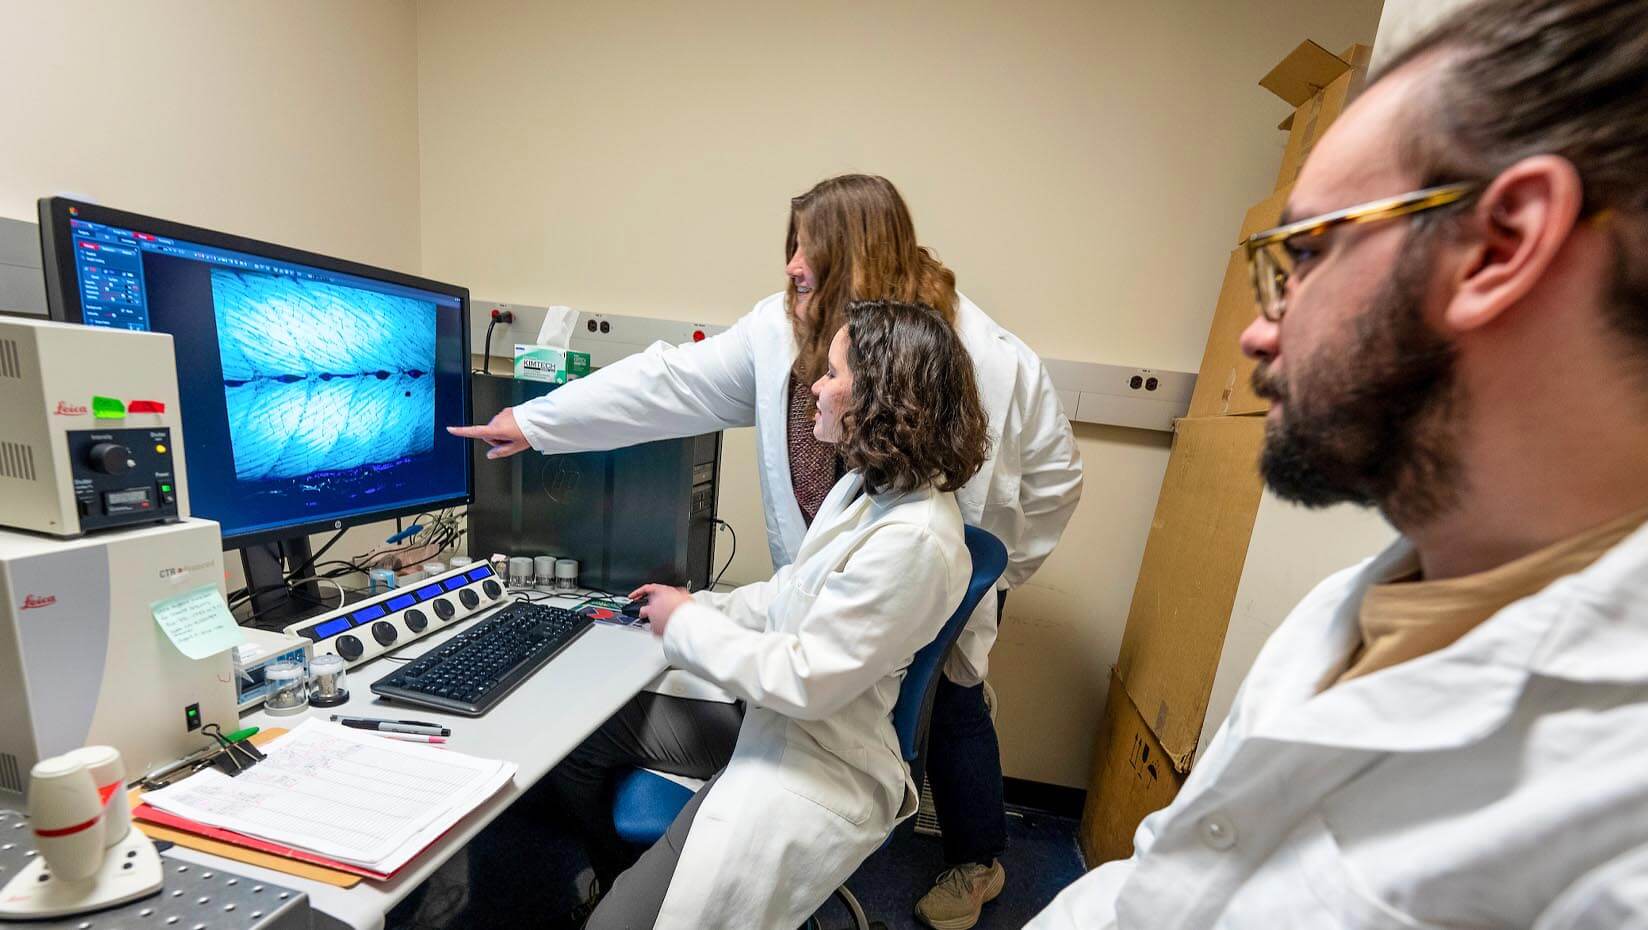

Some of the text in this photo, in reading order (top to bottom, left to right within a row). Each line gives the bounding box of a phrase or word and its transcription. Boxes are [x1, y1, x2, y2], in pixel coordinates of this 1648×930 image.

[524, 359, 556, 369] KIMTECH
[55, 401, 88, 416] Leica
[19, 593, 57, 611] Leica
